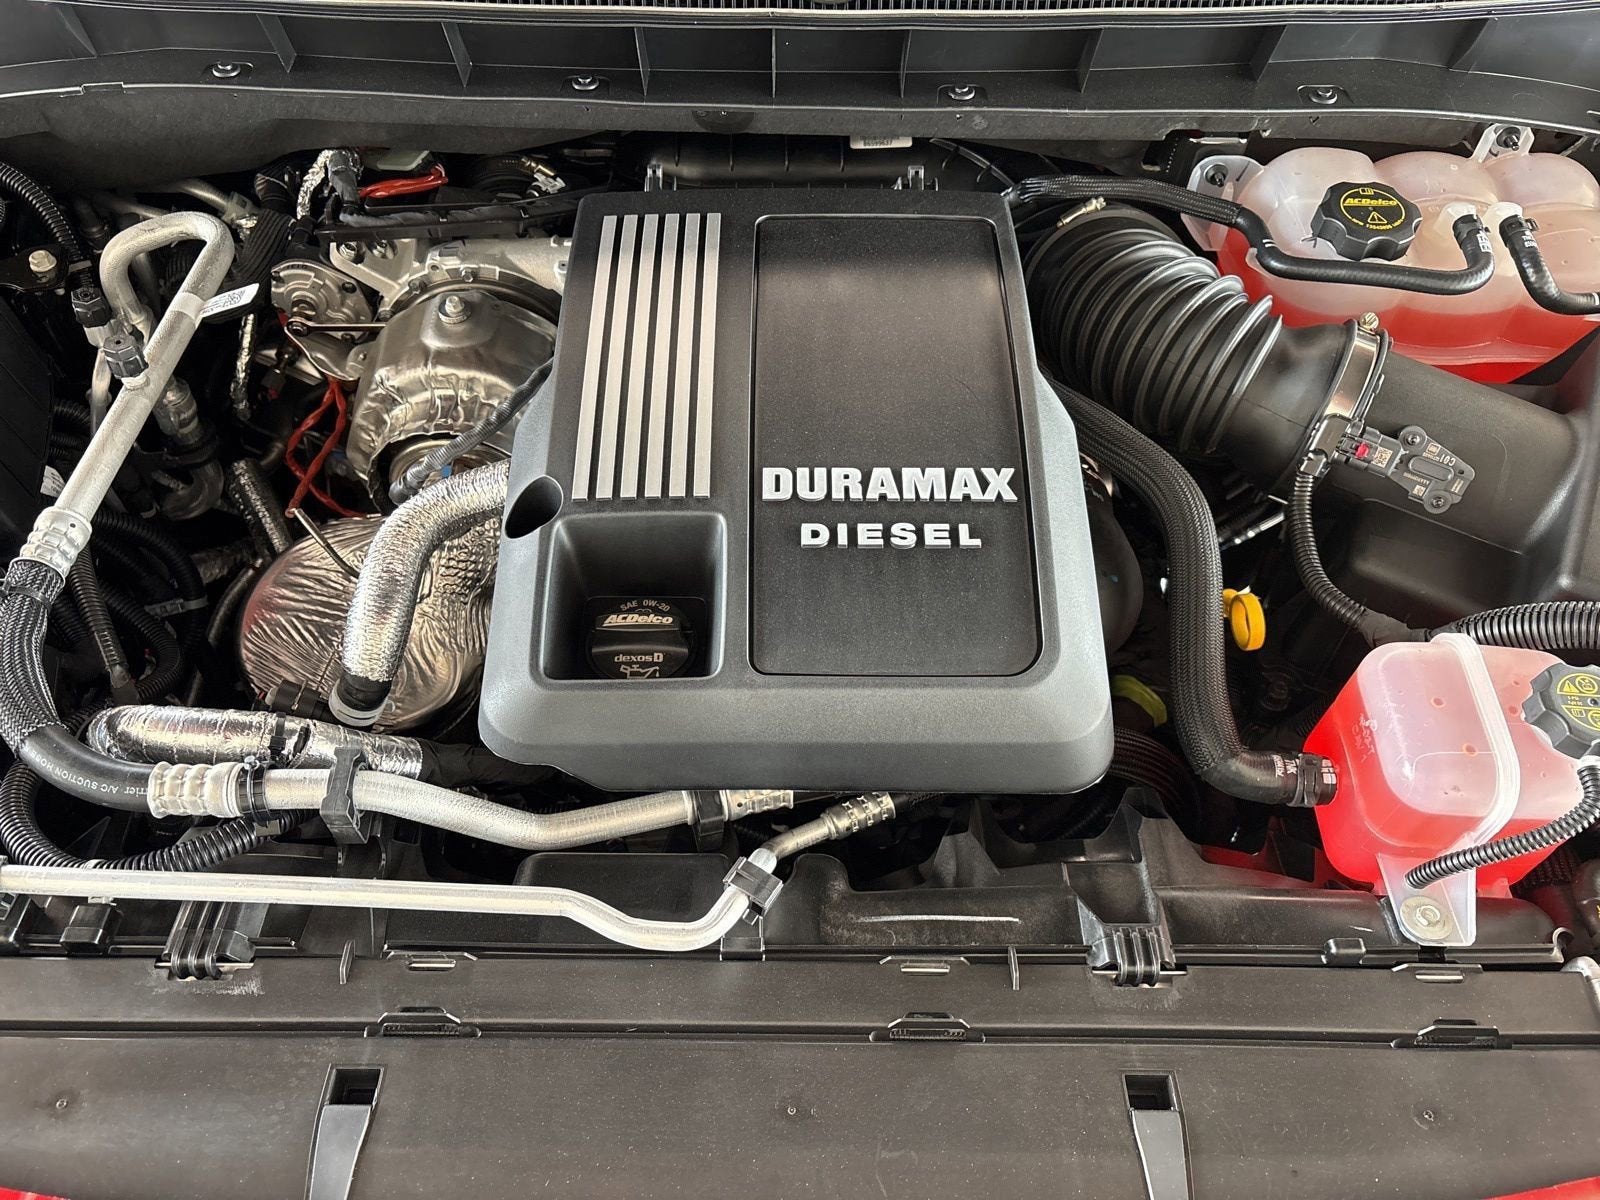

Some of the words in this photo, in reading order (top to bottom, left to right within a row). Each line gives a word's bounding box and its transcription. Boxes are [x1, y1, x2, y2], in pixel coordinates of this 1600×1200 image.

[1343, 197, 1398, 206] ACDelco
[762, 467, 1018, 502] DURAMAX
[801, 522, 982, 549] DIESEL
[620, 600, 639, 611] SAE
[642, 599, 671, 612] 0W-20
[603, 613, 674, 625] ACDelco
[30, 749, 54, 771] HOSE
[54, 766, 99, 790] SUCTION
[100, 783, 119, 795] A/C
